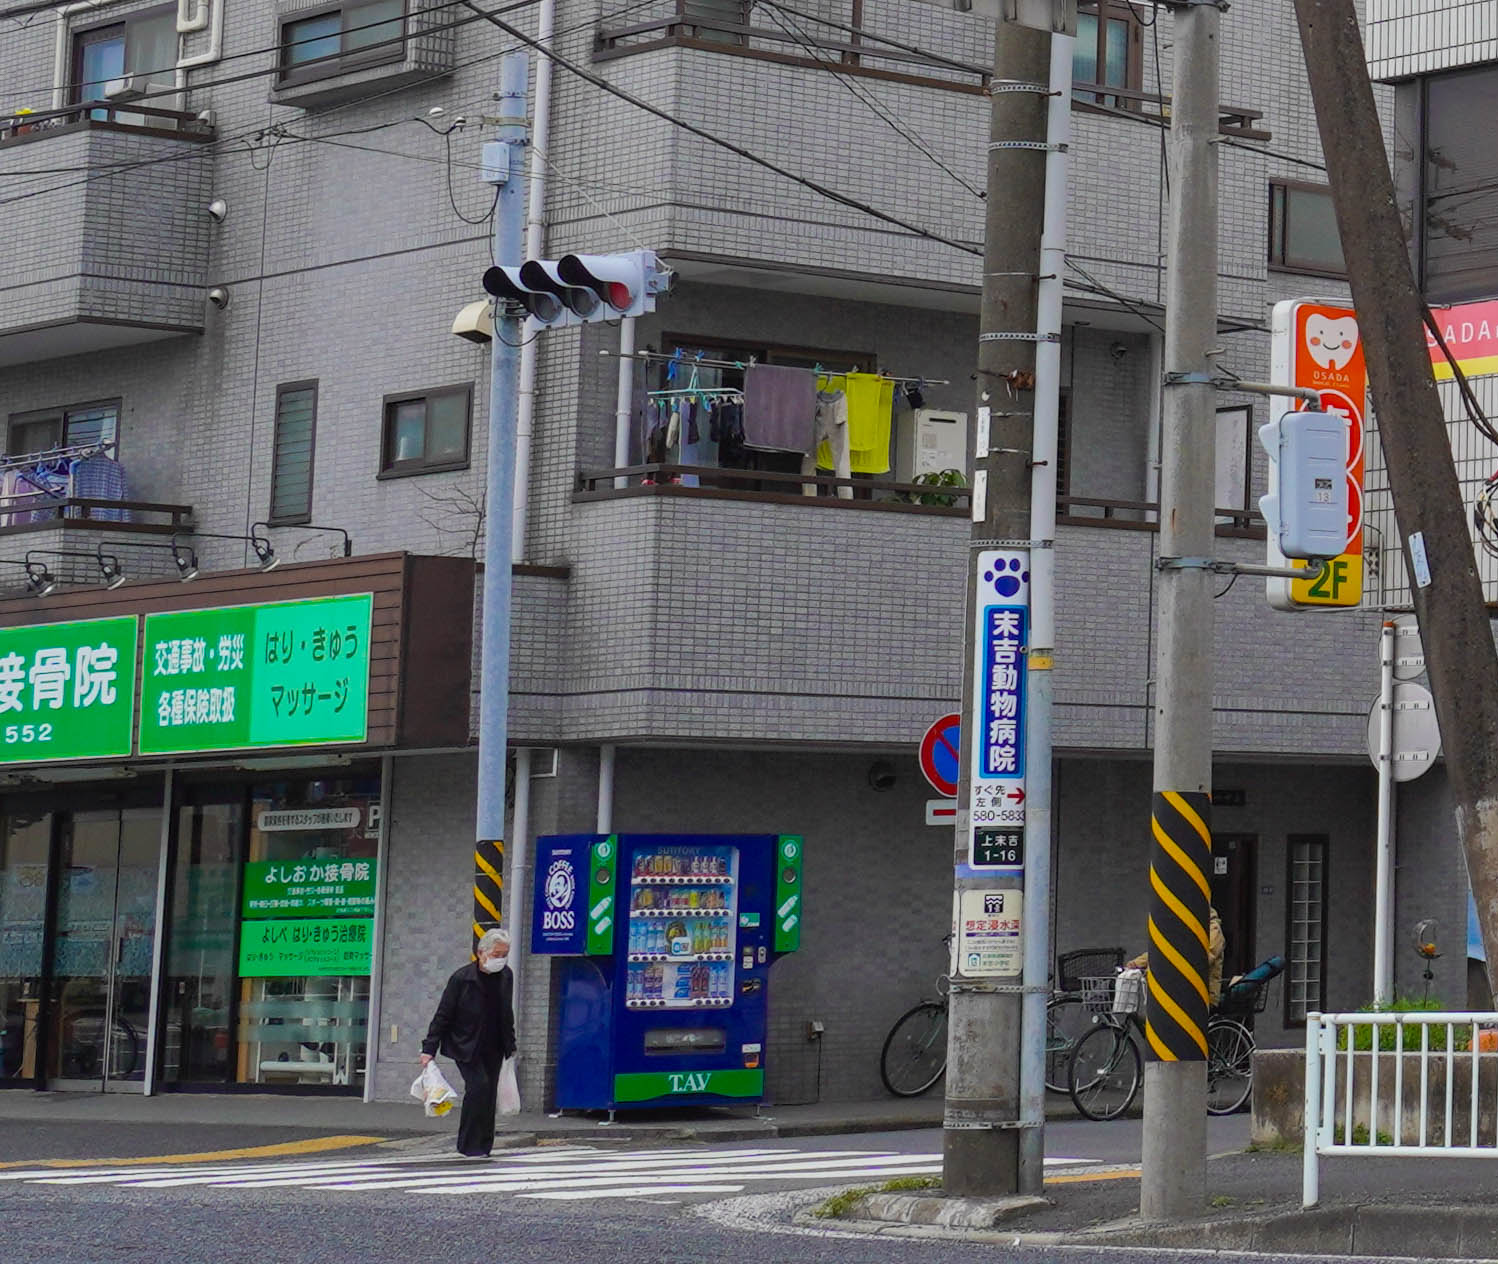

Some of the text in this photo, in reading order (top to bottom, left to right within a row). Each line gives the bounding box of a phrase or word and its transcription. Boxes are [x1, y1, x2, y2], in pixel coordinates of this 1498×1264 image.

[1312, 370, 1350, 384] OSADA
[1307, 561, 1348, 601] 2F
[153, 633, 245, 677] 交通事故・労災
[264, 624, 358, 665] はり・きゅう
[271, 677, 350, 718] マッサージ
[988, 610, 1020, 773] 末吉動物病院
[157, 685, 236, 728] 各種保険取扱
[5, 722, 53, 744] 552
[974, 785, 1007, 797] すぐ先
[975, 796, 1002, 808] 左側
[981, 834, 1019, 847] 上末吉
[984, 849, 1017, 862] 1-16
[264, 862, 370, 884] よしおか接骨院
[542, 910, 575, 930] BOSS
